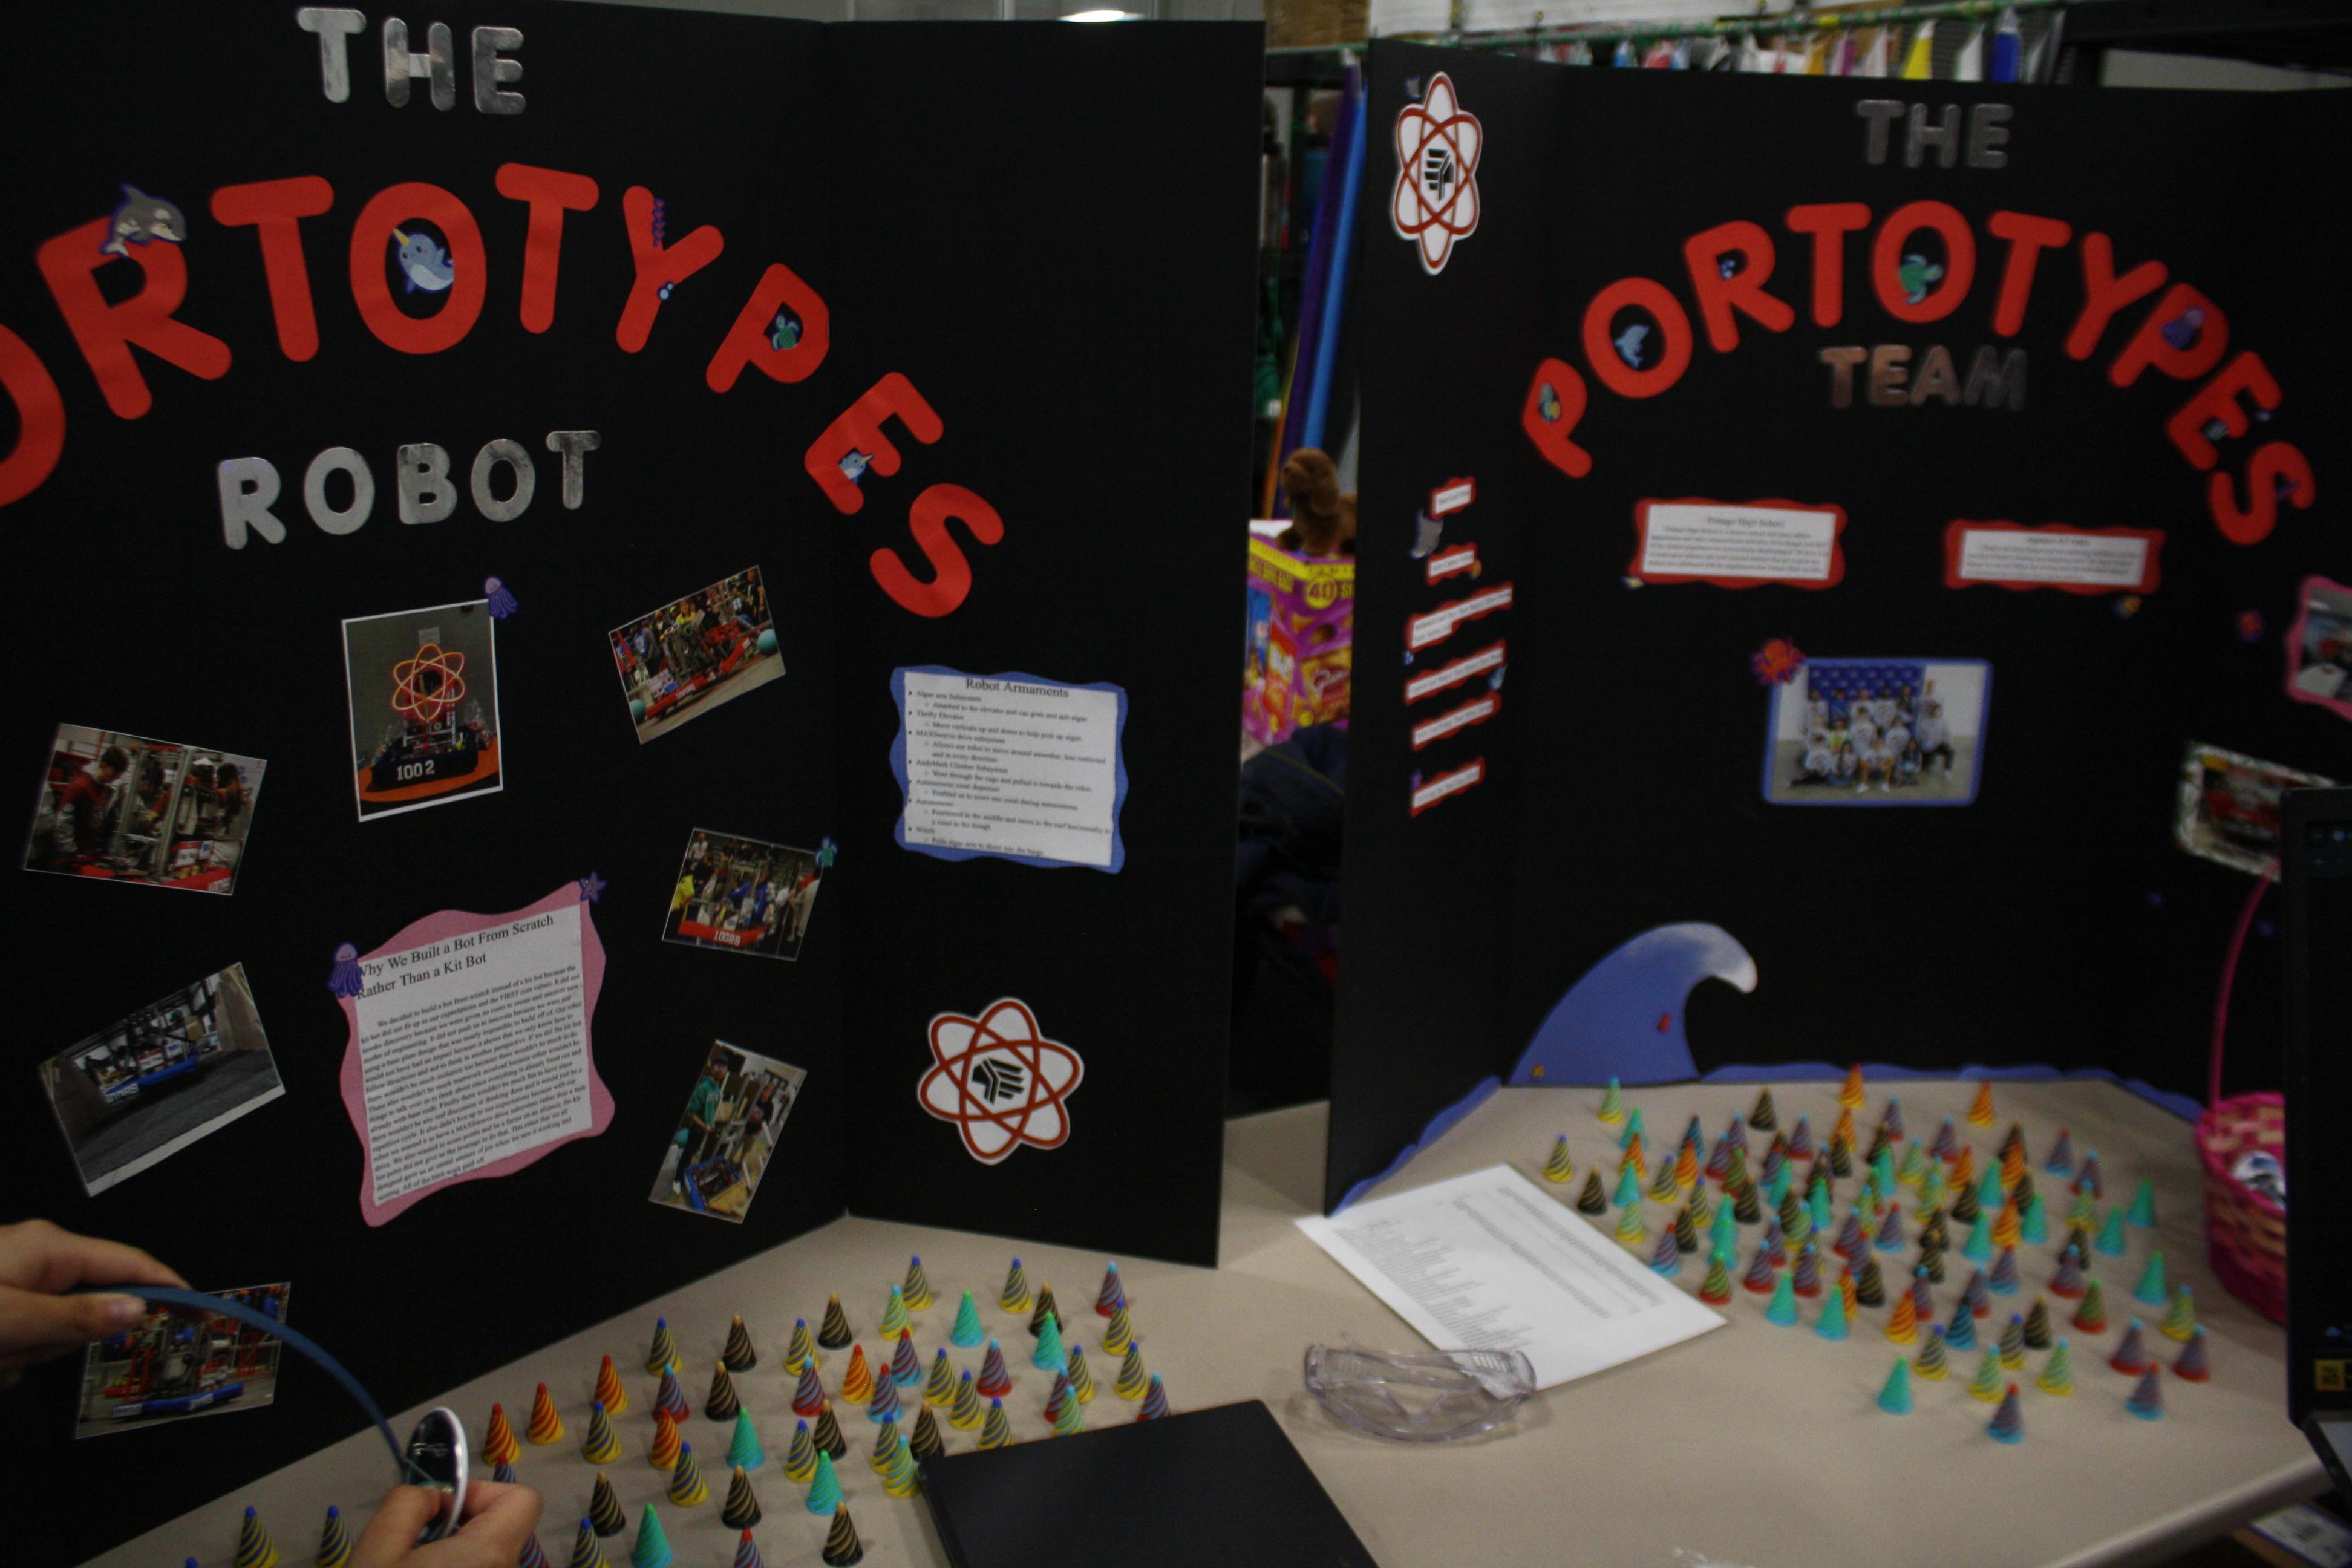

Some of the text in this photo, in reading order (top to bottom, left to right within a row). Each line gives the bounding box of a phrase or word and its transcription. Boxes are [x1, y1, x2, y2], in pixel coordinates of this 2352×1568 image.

[296, 7, 526, 115] THE
[1855, 99, 2014, 168] THE
[1521, 200, 2316, 545] PORTOTYPES
[1820, 344, 2028, 411] TEAM
[217, 430, 601, 550] ROBOT
[966, 678, 1068, 697] Robot Armaments
[396, 759, 436, 781] 1002
[388, 956, 407, 969] We
[411, 946, 439, 963] Built
[443, 945, 450, 954] a
[454, 937, 474, 951] Bot
[479, 929, 508, 944] From
[512, 915, 553, 935] Scratch
[356, 953, 486, 999] Rather Than a Kit Bot
